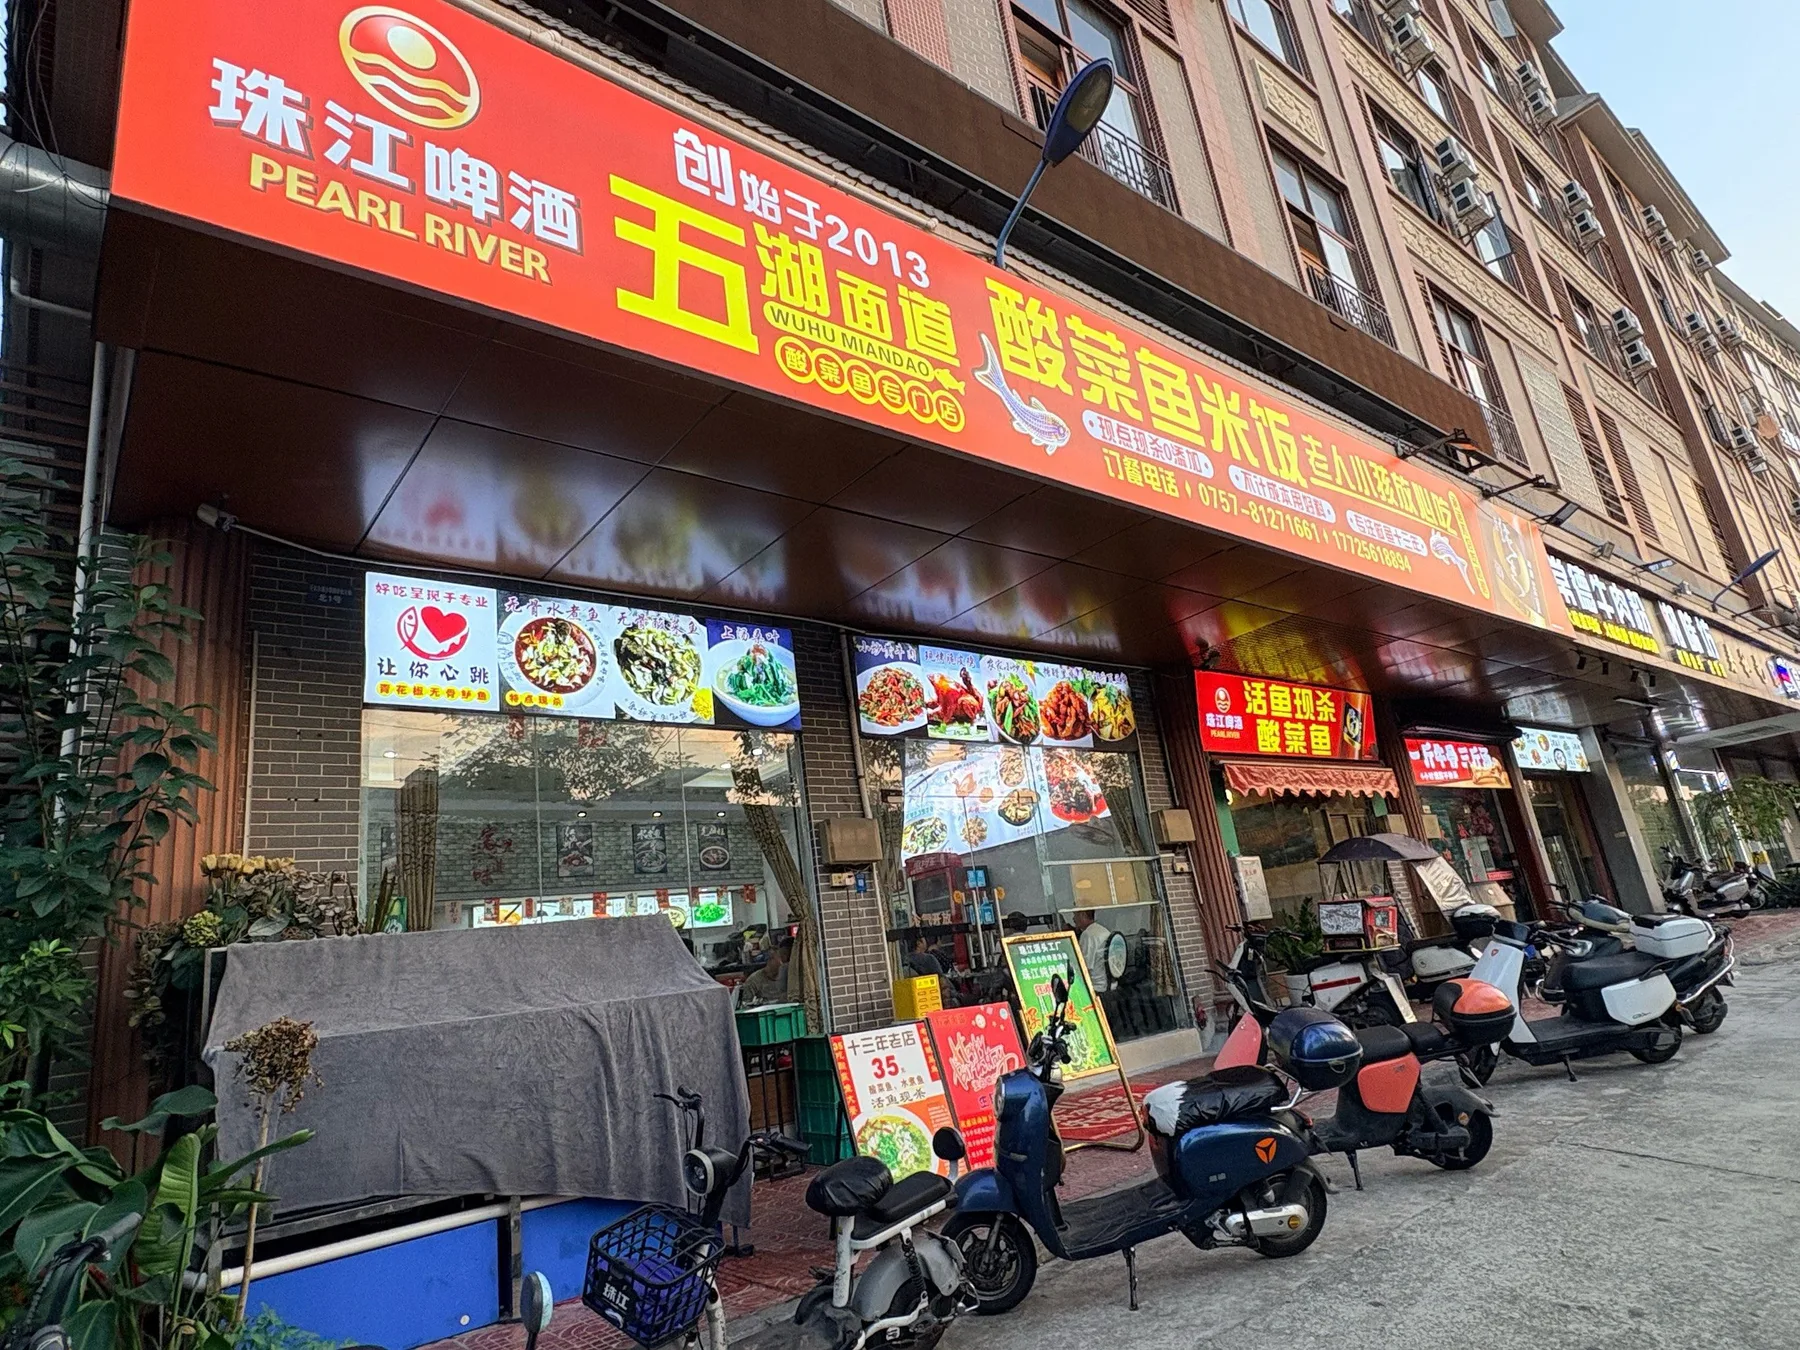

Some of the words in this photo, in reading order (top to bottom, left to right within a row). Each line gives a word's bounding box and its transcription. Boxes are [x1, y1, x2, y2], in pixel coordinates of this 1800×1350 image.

[208, 57, 582, 254] 珠江啤酒
[249, 154, 418, 239] PEARL
[424, 215, 551, 283] RIVER
[673, 128, 930, 288] 创始于2013
[609, 173, 959, 366] 五湖面道
[771, 306, 836, 343] WUHU
[841, 332, 931, 378] MIANDAO
[784, 347, 959, 425] 酸菜鱼专门店
[985, 277, 1308, 489] 酸菜鱼米饭
[1098, 415, 1204, 474] 现点现杀0添加
[1102, 448, 1180, 498] 订餐电话
[1198, 485, 1319, 544] 0757-81271661
[1241, 470, 1327, 518] 不计成本用好料
[1301, 434, 1457, 536] 老人小孩放心吃
[375, 582, 488, 608] 好吃呈现于专业
[504, 596, 601, 622] 无骨水煮鱼
[617, 612, 700, 636] 无骨酸菜鱼
[377, 657, 489, 684] 让你心跳
[1206, 713, 1243, 730] 珠江啤酒
[1243, 680, 1336, 722] 活鱼现杀
[1256, 719, 1332, 756] 酸菜鱼
[848, 1031, 916, 1056] 十三年老店
[871, 1055, 899, 1079] 35
[871, 1088, 926, 1109] 活鱼现杀
